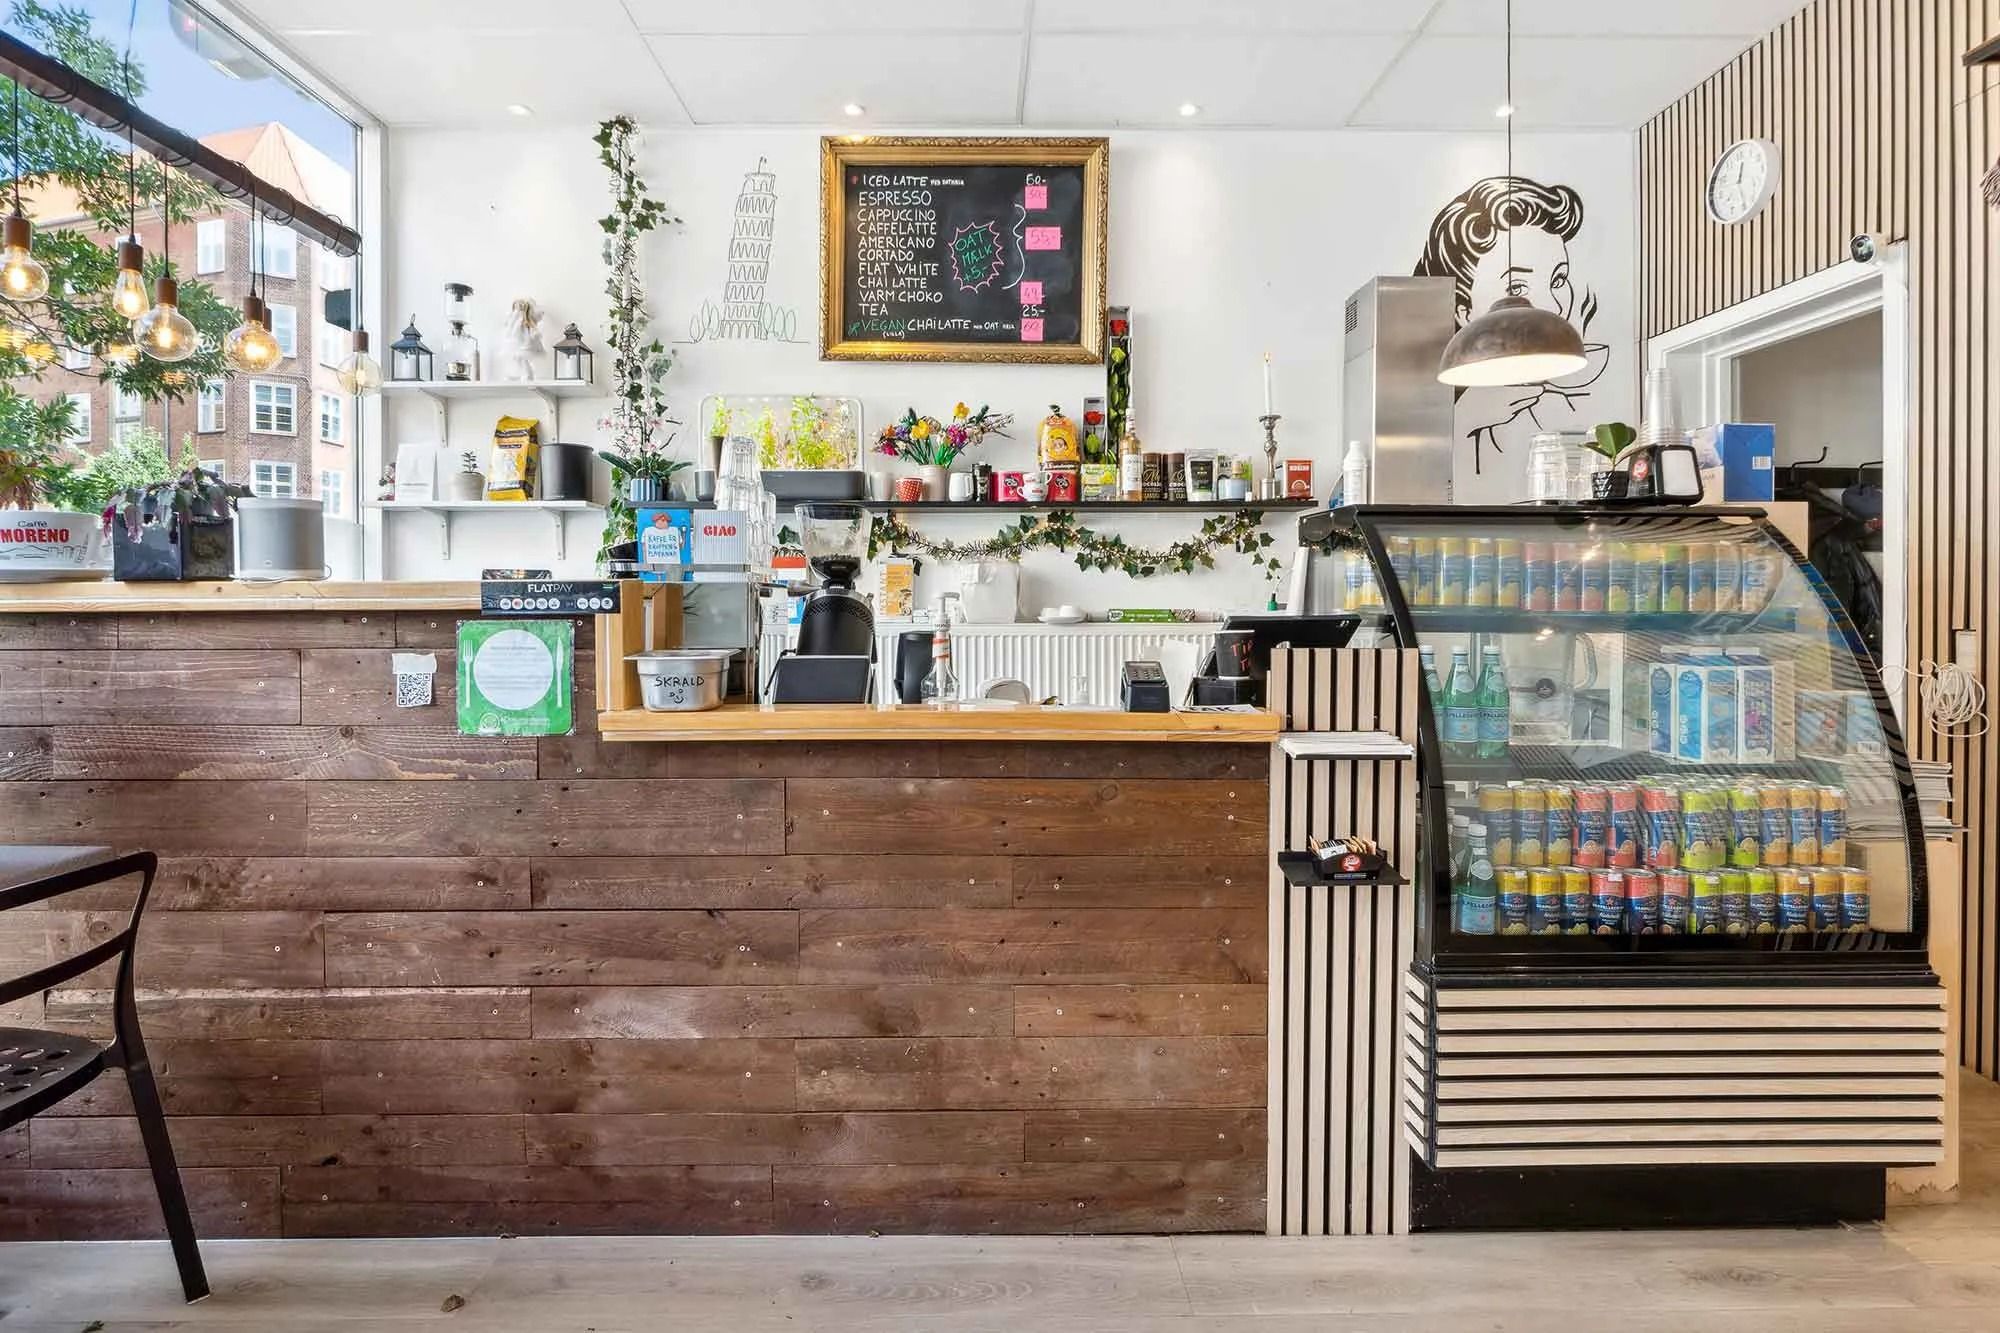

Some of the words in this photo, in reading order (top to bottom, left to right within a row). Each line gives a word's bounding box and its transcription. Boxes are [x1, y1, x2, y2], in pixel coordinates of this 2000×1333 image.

[863, 174, 890, 187] ICED
[893, 175, 929, 186] LATTE
[859, 190, 932, 206] ESPRESSO
[857, 208, 936, 222] CAPPUCCINO
[857, 222, 937, 235] CAFFELATTE
[858, 235, 936, 249] AMERICANO
[955, 228, 987, 251] OAT
[858, 248, 914, 261] CORTADO
[859, 262, 890, 276] FLAT
[894, 261, 939, 276] WHITE
[857, 275, 888, 288] CHAI
[892, 277, 927, 289] LATTE
[859, 290, 895, 303] VARM
[898, 290, 943, 303] CHOKO
[858, 303, 888, 316] TEA
[861, 319, 905, 331] VEGAN
[984, 321, 999, 330] OAT
[0, 528, 70, 543] MORENO
[527, 583, 574, 593] FLATPAY
[654, 675, 705, 688] SKRALD
